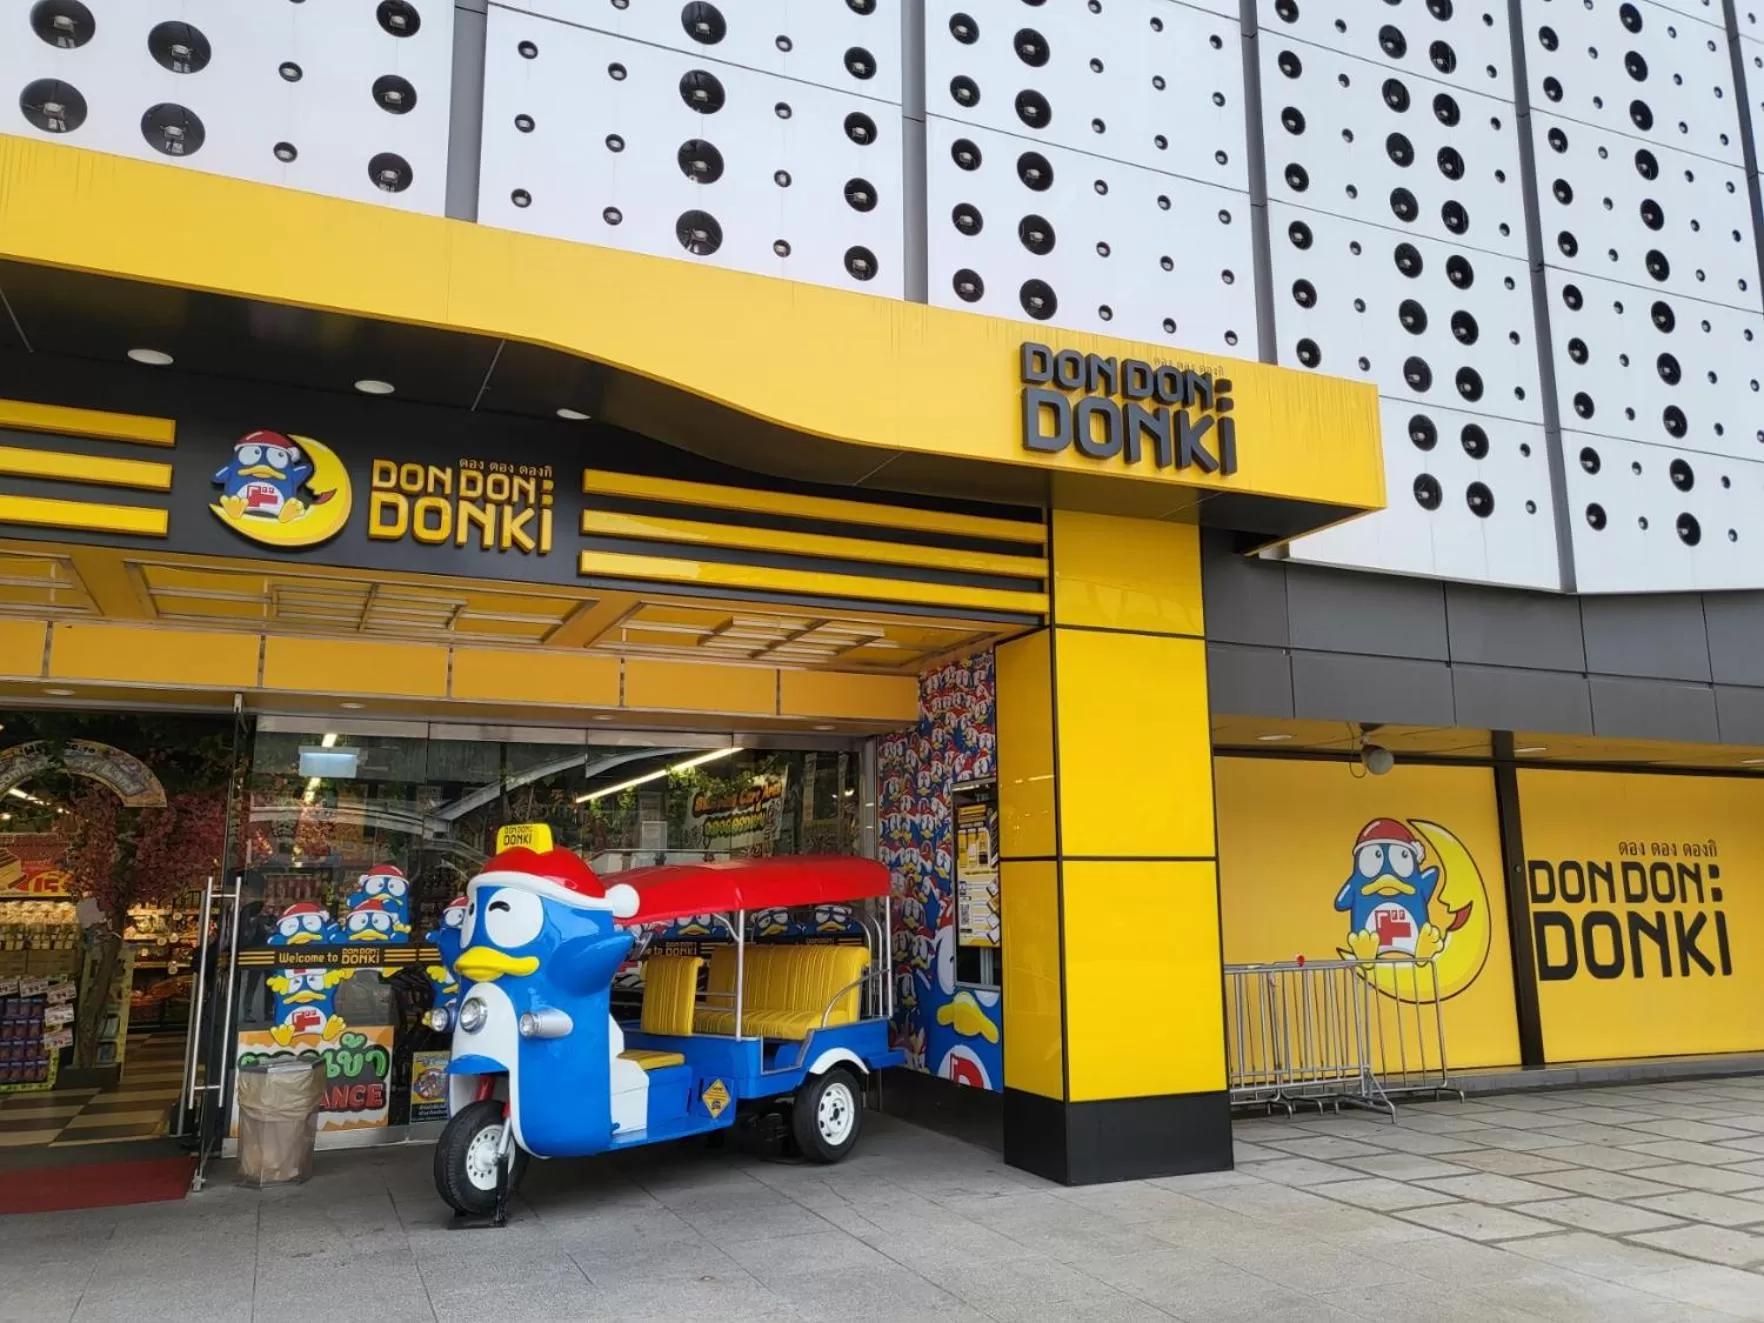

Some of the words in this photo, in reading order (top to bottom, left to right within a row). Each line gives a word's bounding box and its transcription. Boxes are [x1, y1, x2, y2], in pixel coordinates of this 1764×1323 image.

[1020, 341, 1117, 396] DON
[1022, 386, 1238, 476] DONKI
[370, 458, 451, 494] DON
[367, 491, 553, 555] DONKI
[1618, 841, 1646, 856] ดอง
[1651, 842, 1678, 856] ดอง
[1528, 860, 1616, 904] DON
[279, 952, 325, 964] Welcome
[327, 952, 338, 963] to
[341, 954, 380, 965] DONKI
[1532, 910, 1733, 982] DONKI
